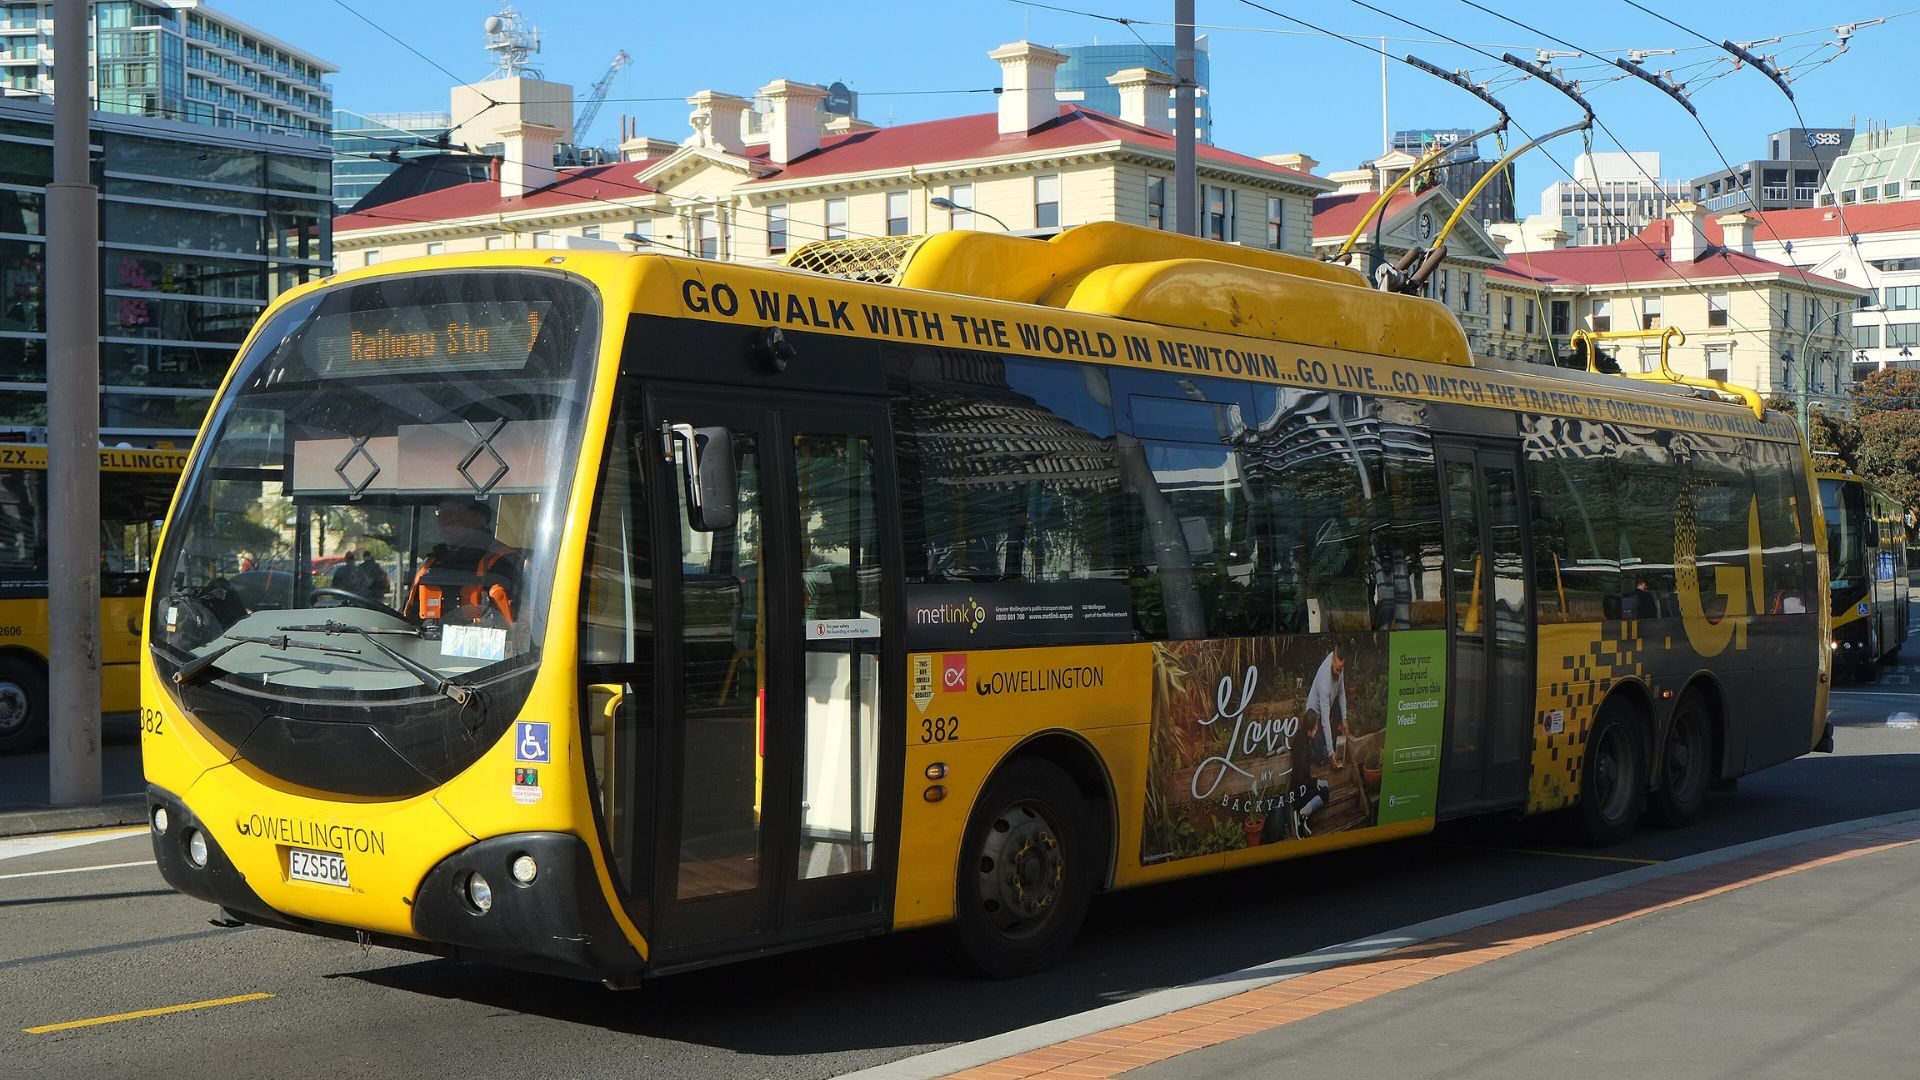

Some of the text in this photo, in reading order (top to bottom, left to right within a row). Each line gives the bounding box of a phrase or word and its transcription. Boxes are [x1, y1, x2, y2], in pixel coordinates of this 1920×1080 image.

[1434, 133, 1459, 141] TSB
[352, 328, 435, 361] Railway
[448, 321, 489, 354] Stn
[682, 279, 738, 317] GO
[749, 288, 855, 331] WALK
[861, 304, 944, 341] WITH
[951, 314, 1010, 348] THE
[1016, 322, 1117, 358] WORLD
[1123, 335, 1152, 362] IN
[1422, 374, 1484, 402] WATCH
[1486, 383, 1519, 407] THE
[1519, 388, 1584, 416] TRAFFIC
[1586, 397, 1602, 418] AT
[1607, 398, 1671, 425] ORIENTAL
[1724, 415, 1794, 438] WELLINGTON
[99, 453, 188, 469] ELLINGTO
[917, 604, 970, 624] metlink
[1400, 654, 1431, 667] Show your
[975, 666, 1104, 696] GOWELLINGTON
[1399, 668, 1427, 682] backyard
[1399, 682, 1441, 696] some love this
[1398, 698, 1439, 711] Conservation
[921, 716, 959, 743] 382
[1191, 665, 1299, 799] Love
[1260, 771, 1274, 781] MY
[1221, 784, 1307, 813] BACKYARD
[236, 814, 385, 855] GOWELLINGTON
[292, 852, 348, 882] EZS560
